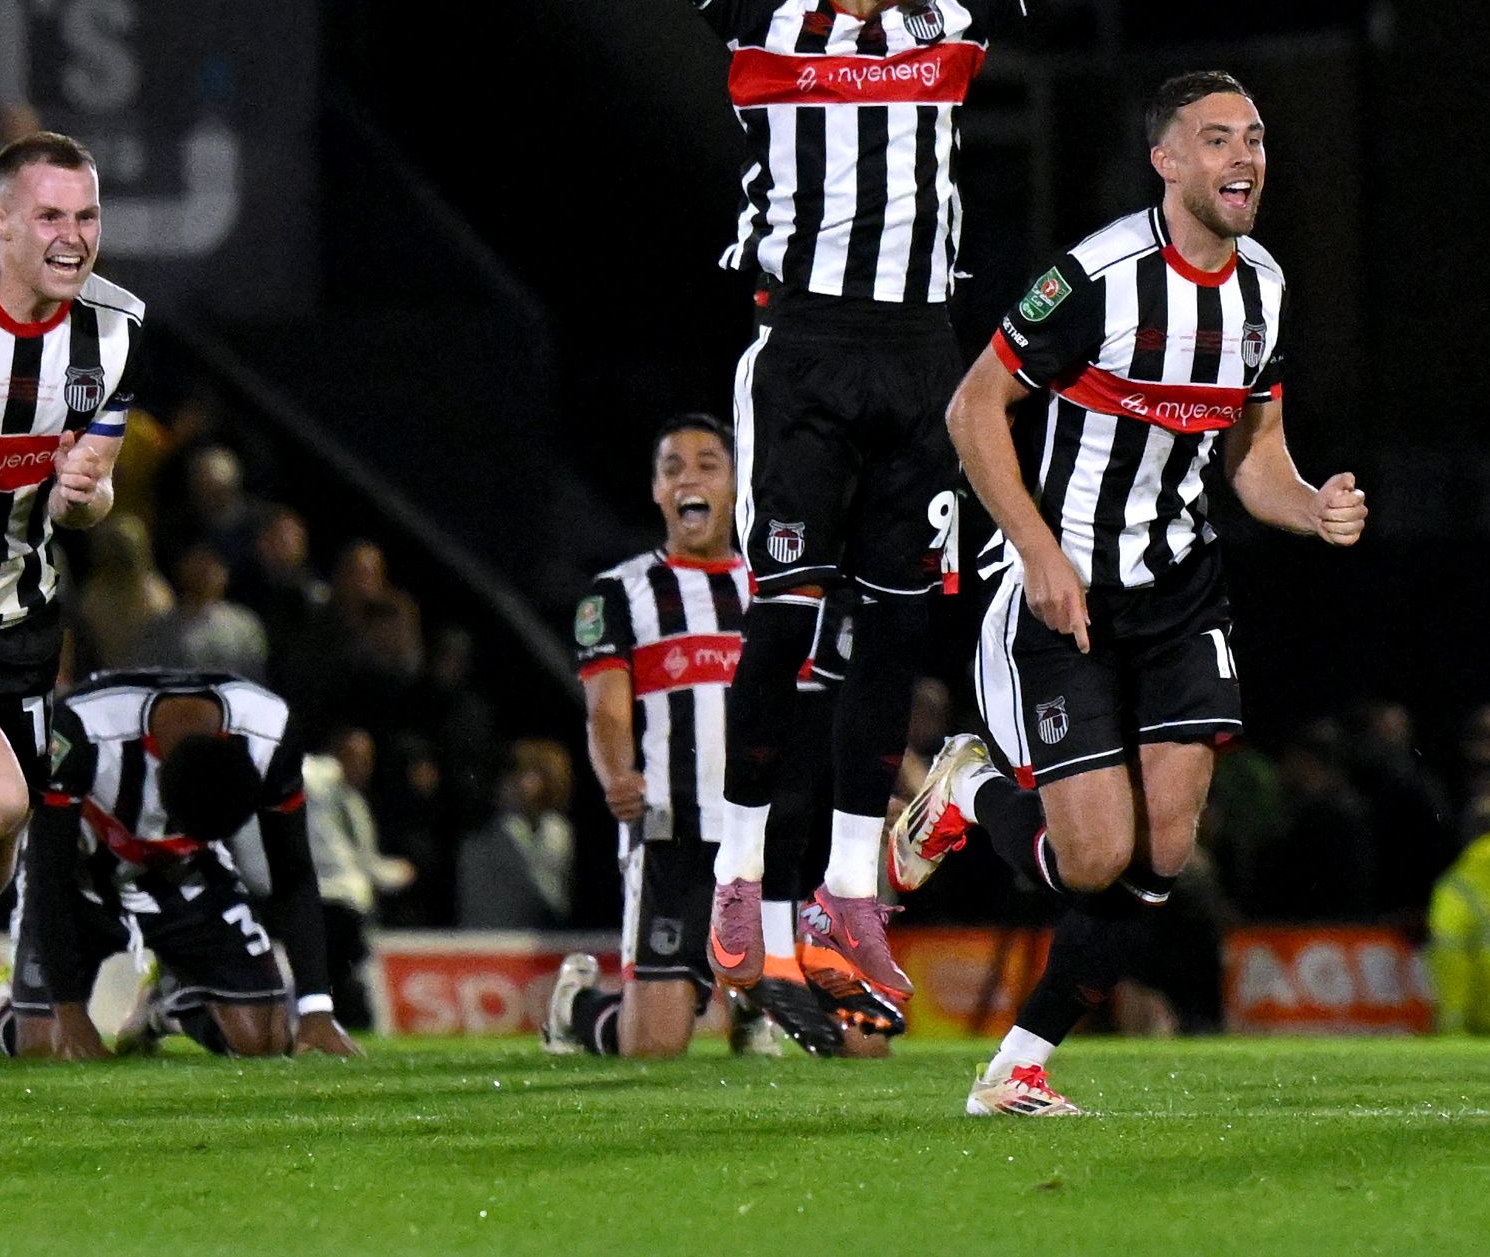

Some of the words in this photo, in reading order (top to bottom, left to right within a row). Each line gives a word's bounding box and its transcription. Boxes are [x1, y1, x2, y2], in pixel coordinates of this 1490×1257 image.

[1199, 623, 1238, 681] 1
[21, 690, 54, 758] 1
[221, 902, 271, 957] 3
